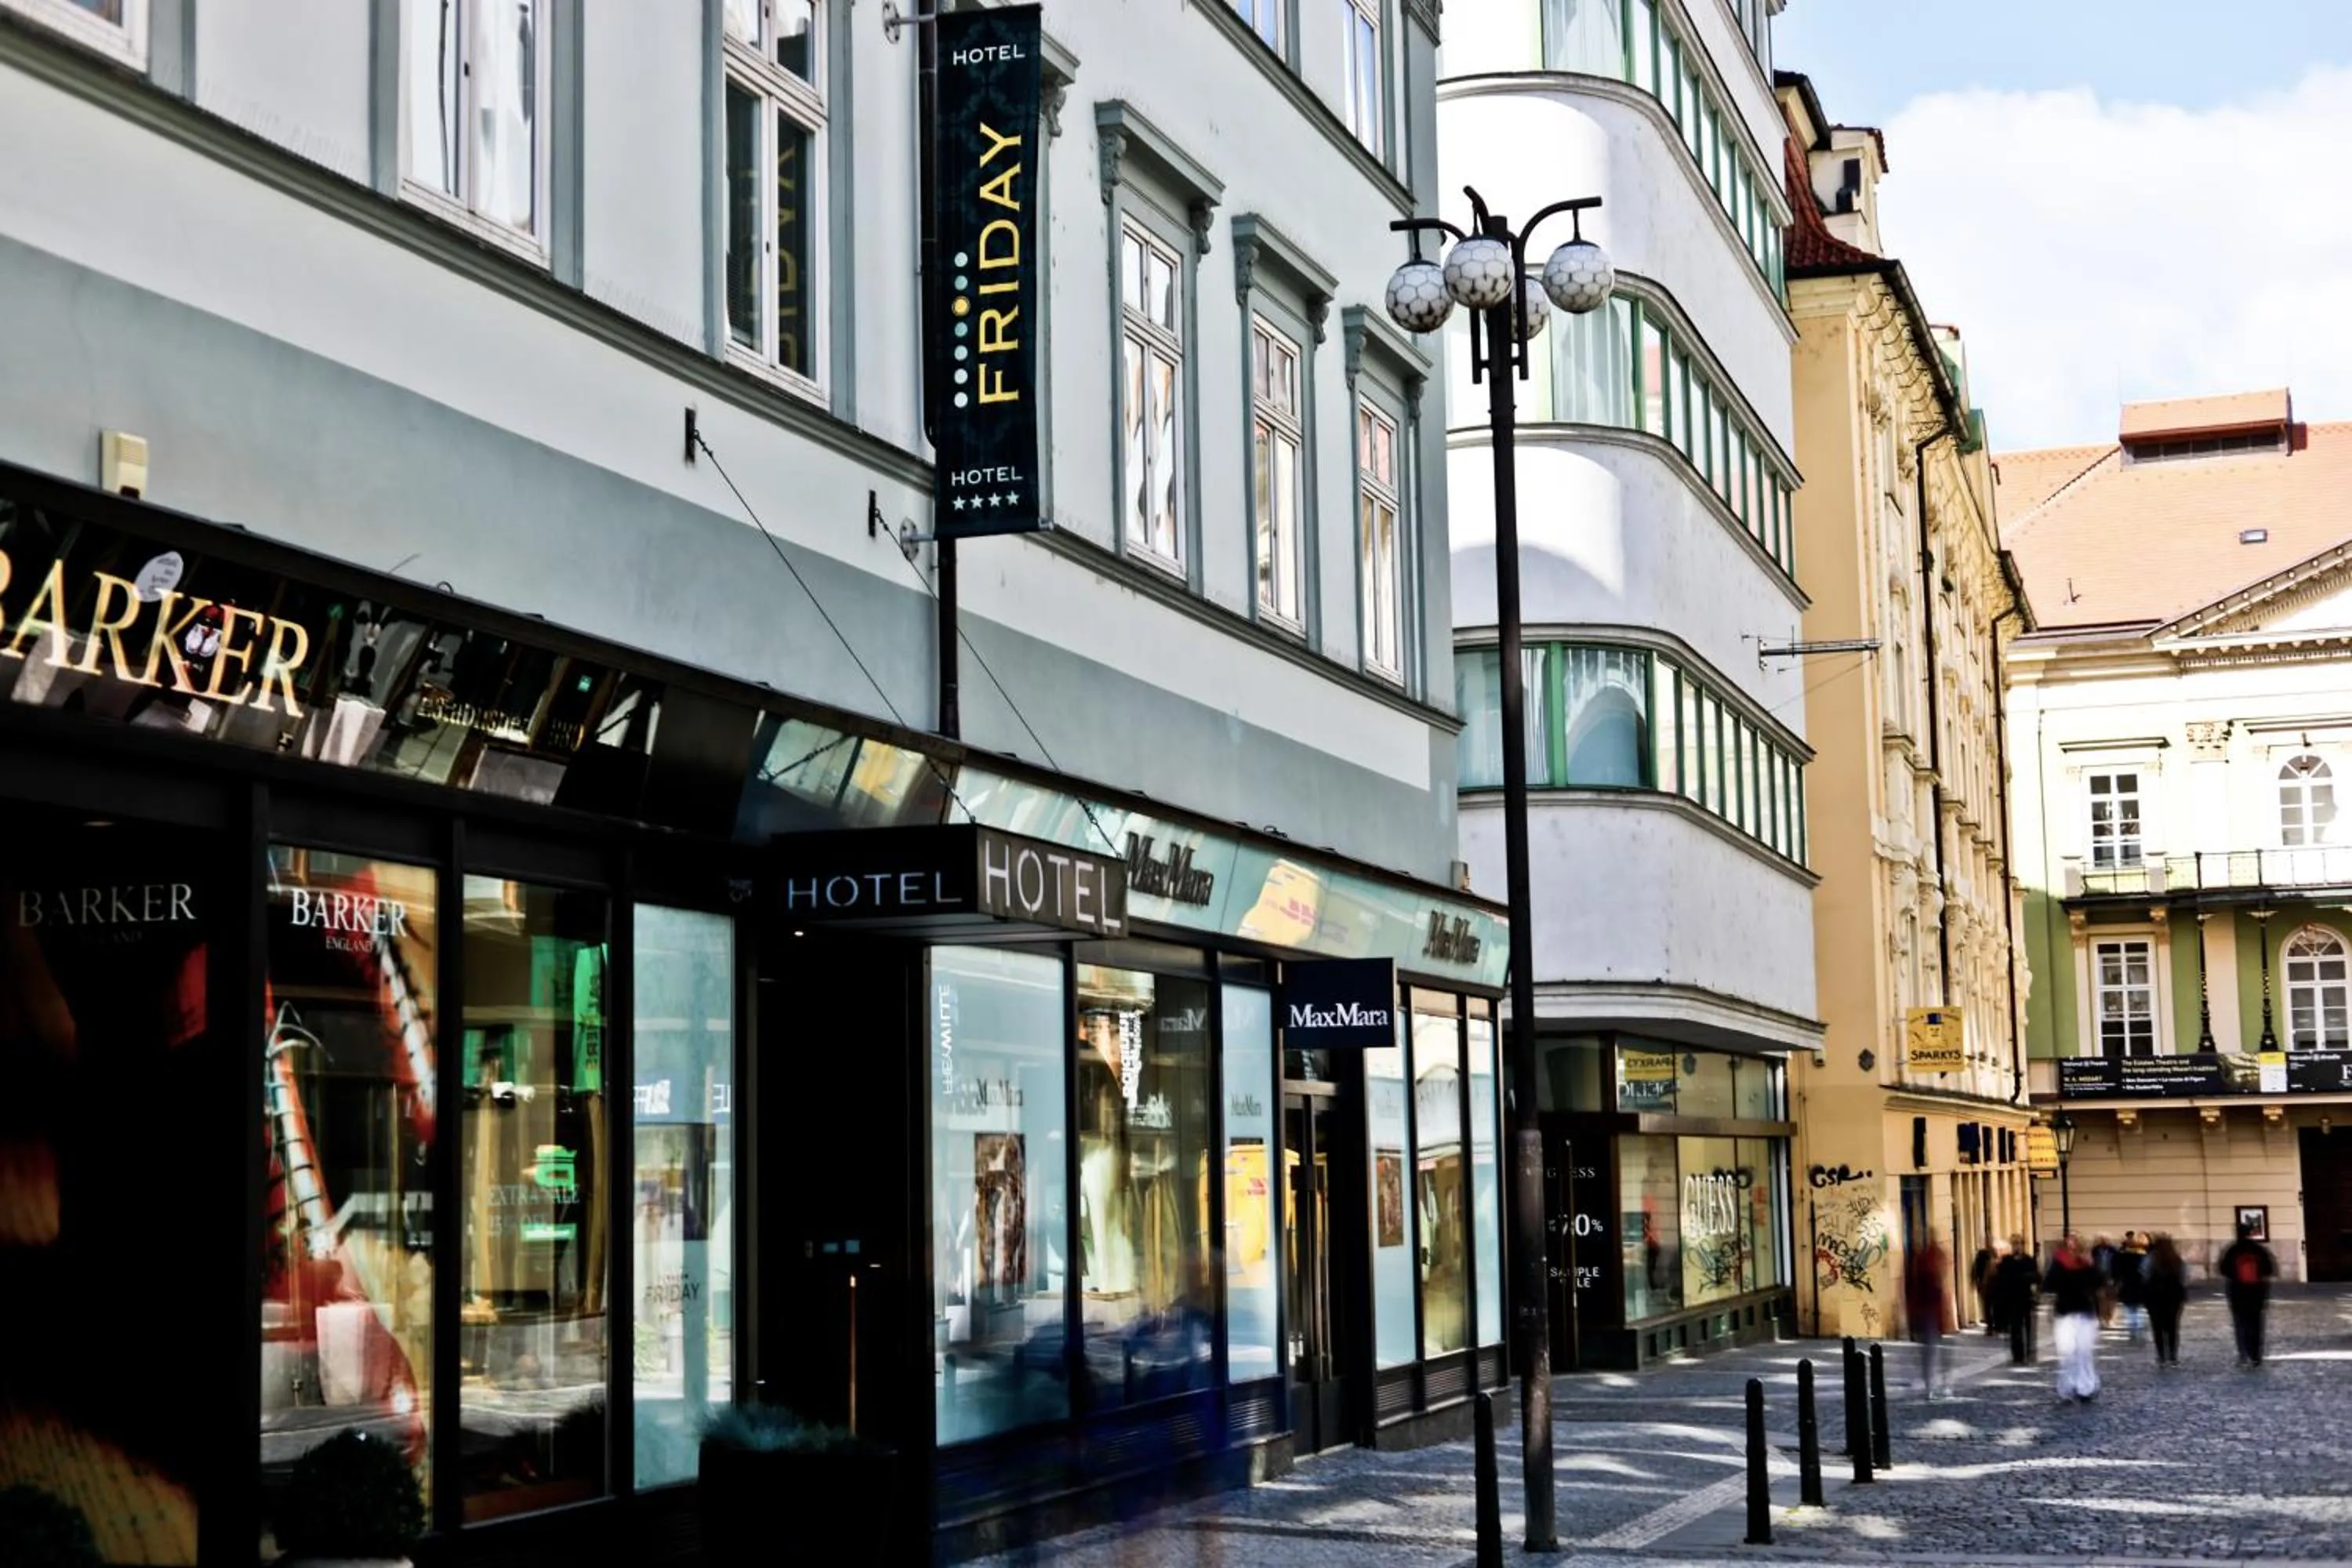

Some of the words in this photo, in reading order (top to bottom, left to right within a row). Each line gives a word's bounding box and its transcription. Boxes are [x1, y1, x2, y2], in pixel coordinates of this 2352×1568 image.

[953, 44, 1025, 66] HOTEL
[978, 122, 1022, 405] FRIDAY
[951, 466, 1023, 487] HOTEL
[789, 872, 962, 909] HOTEL
[985, 839, 1122, 929] HOTEL
[18, 883, 198, 927] BARKER
[292, 887, 408, 938] BARKER
[1289, 1002, 1388, 1028] MaxMara
[1911, 1049, 1962, 1061] SPARKYS
[1547, 1166, 1596, 1178] GESS
[1683, 1173, 1736, 1236] GUESS
